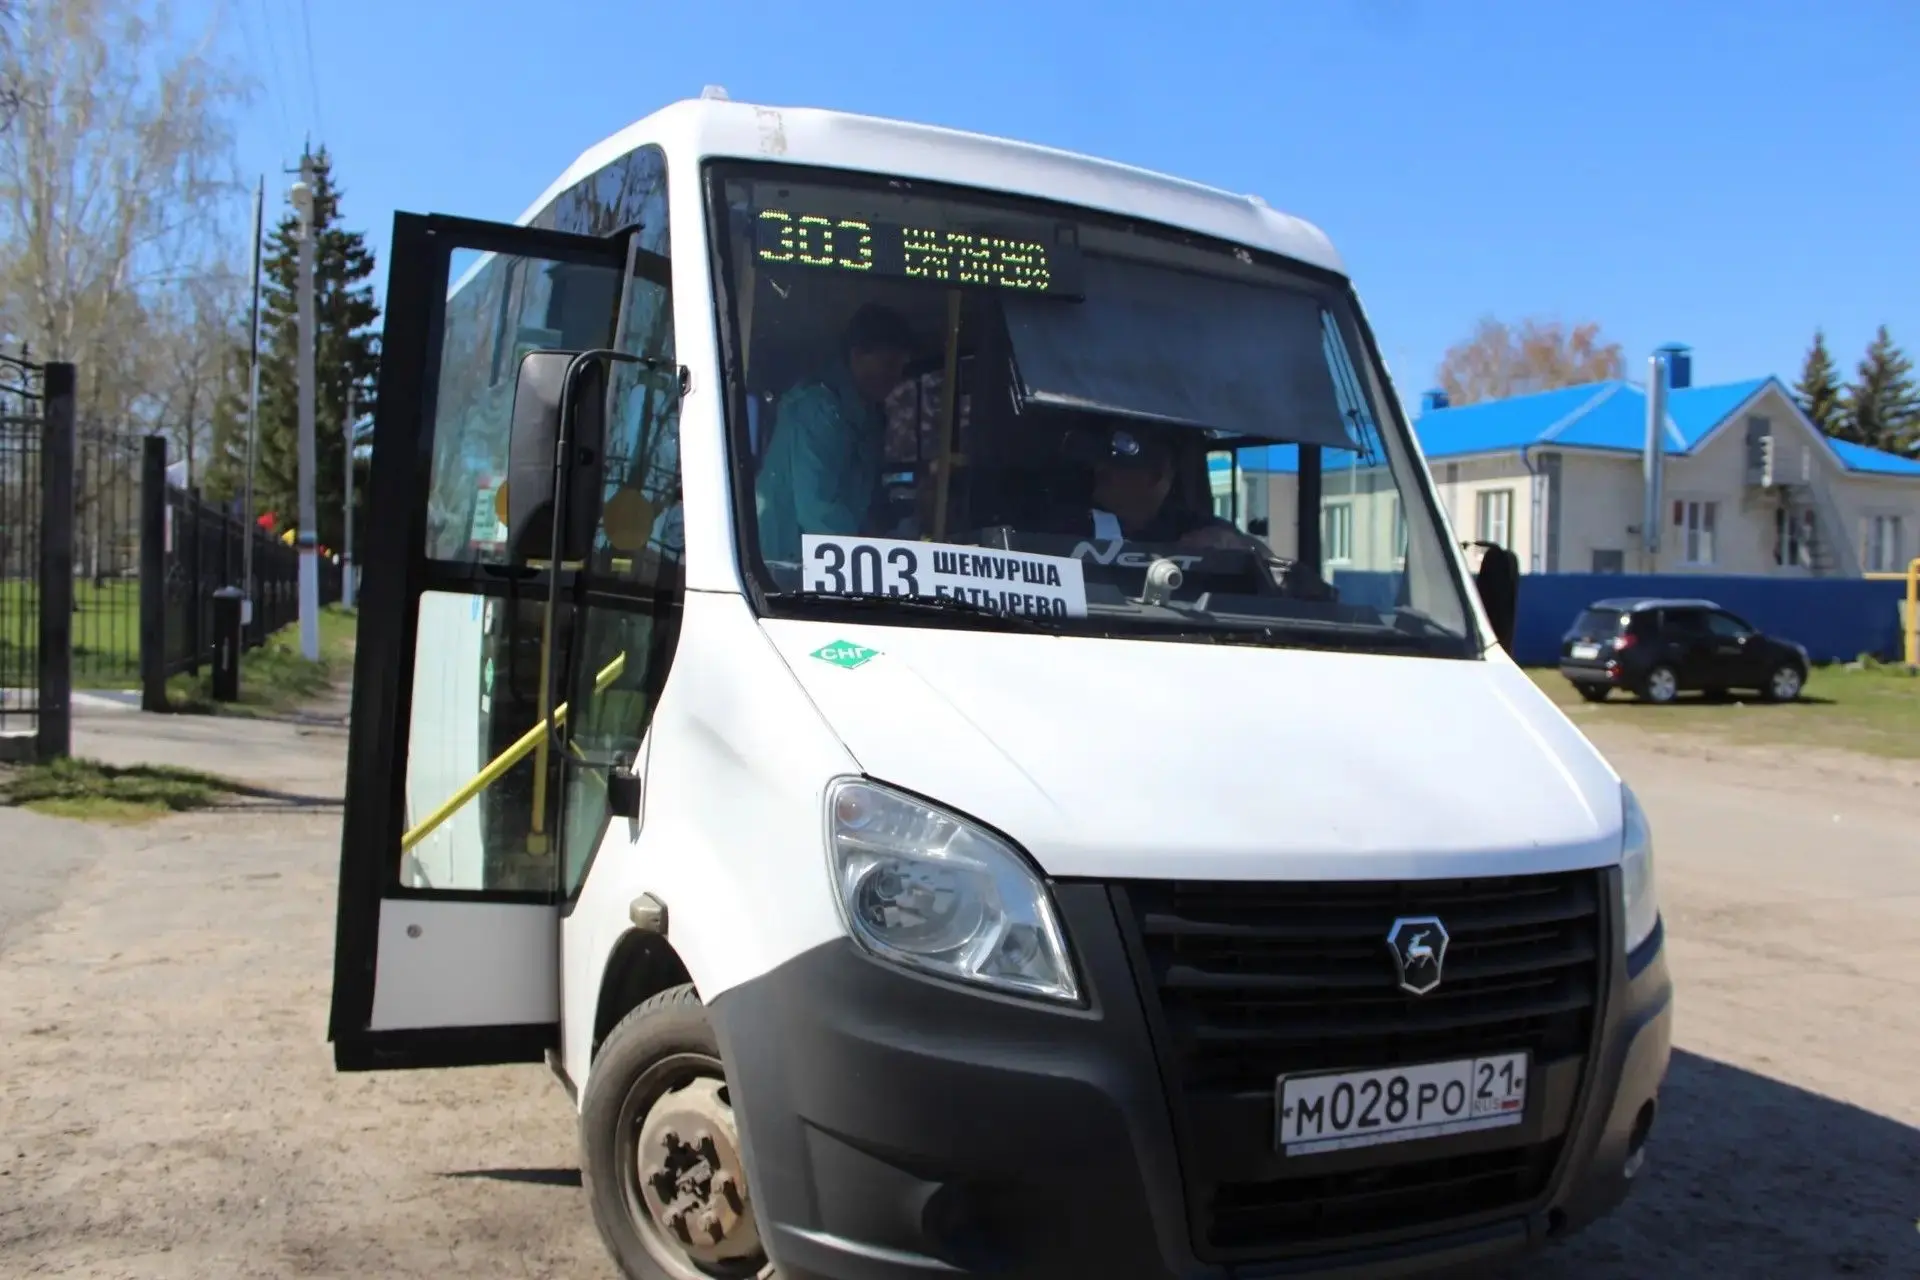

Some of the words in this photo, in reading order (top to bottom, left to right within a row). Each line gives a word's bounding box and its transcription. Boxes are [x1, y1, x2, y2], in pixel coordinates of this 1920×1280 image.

[759, 209, 872, 270] 303
[814, 542, 919, 597] 303
[932, 550, 1061, 587] ШЕМУРША
[1477, 1059, 1514, 1099] 21
